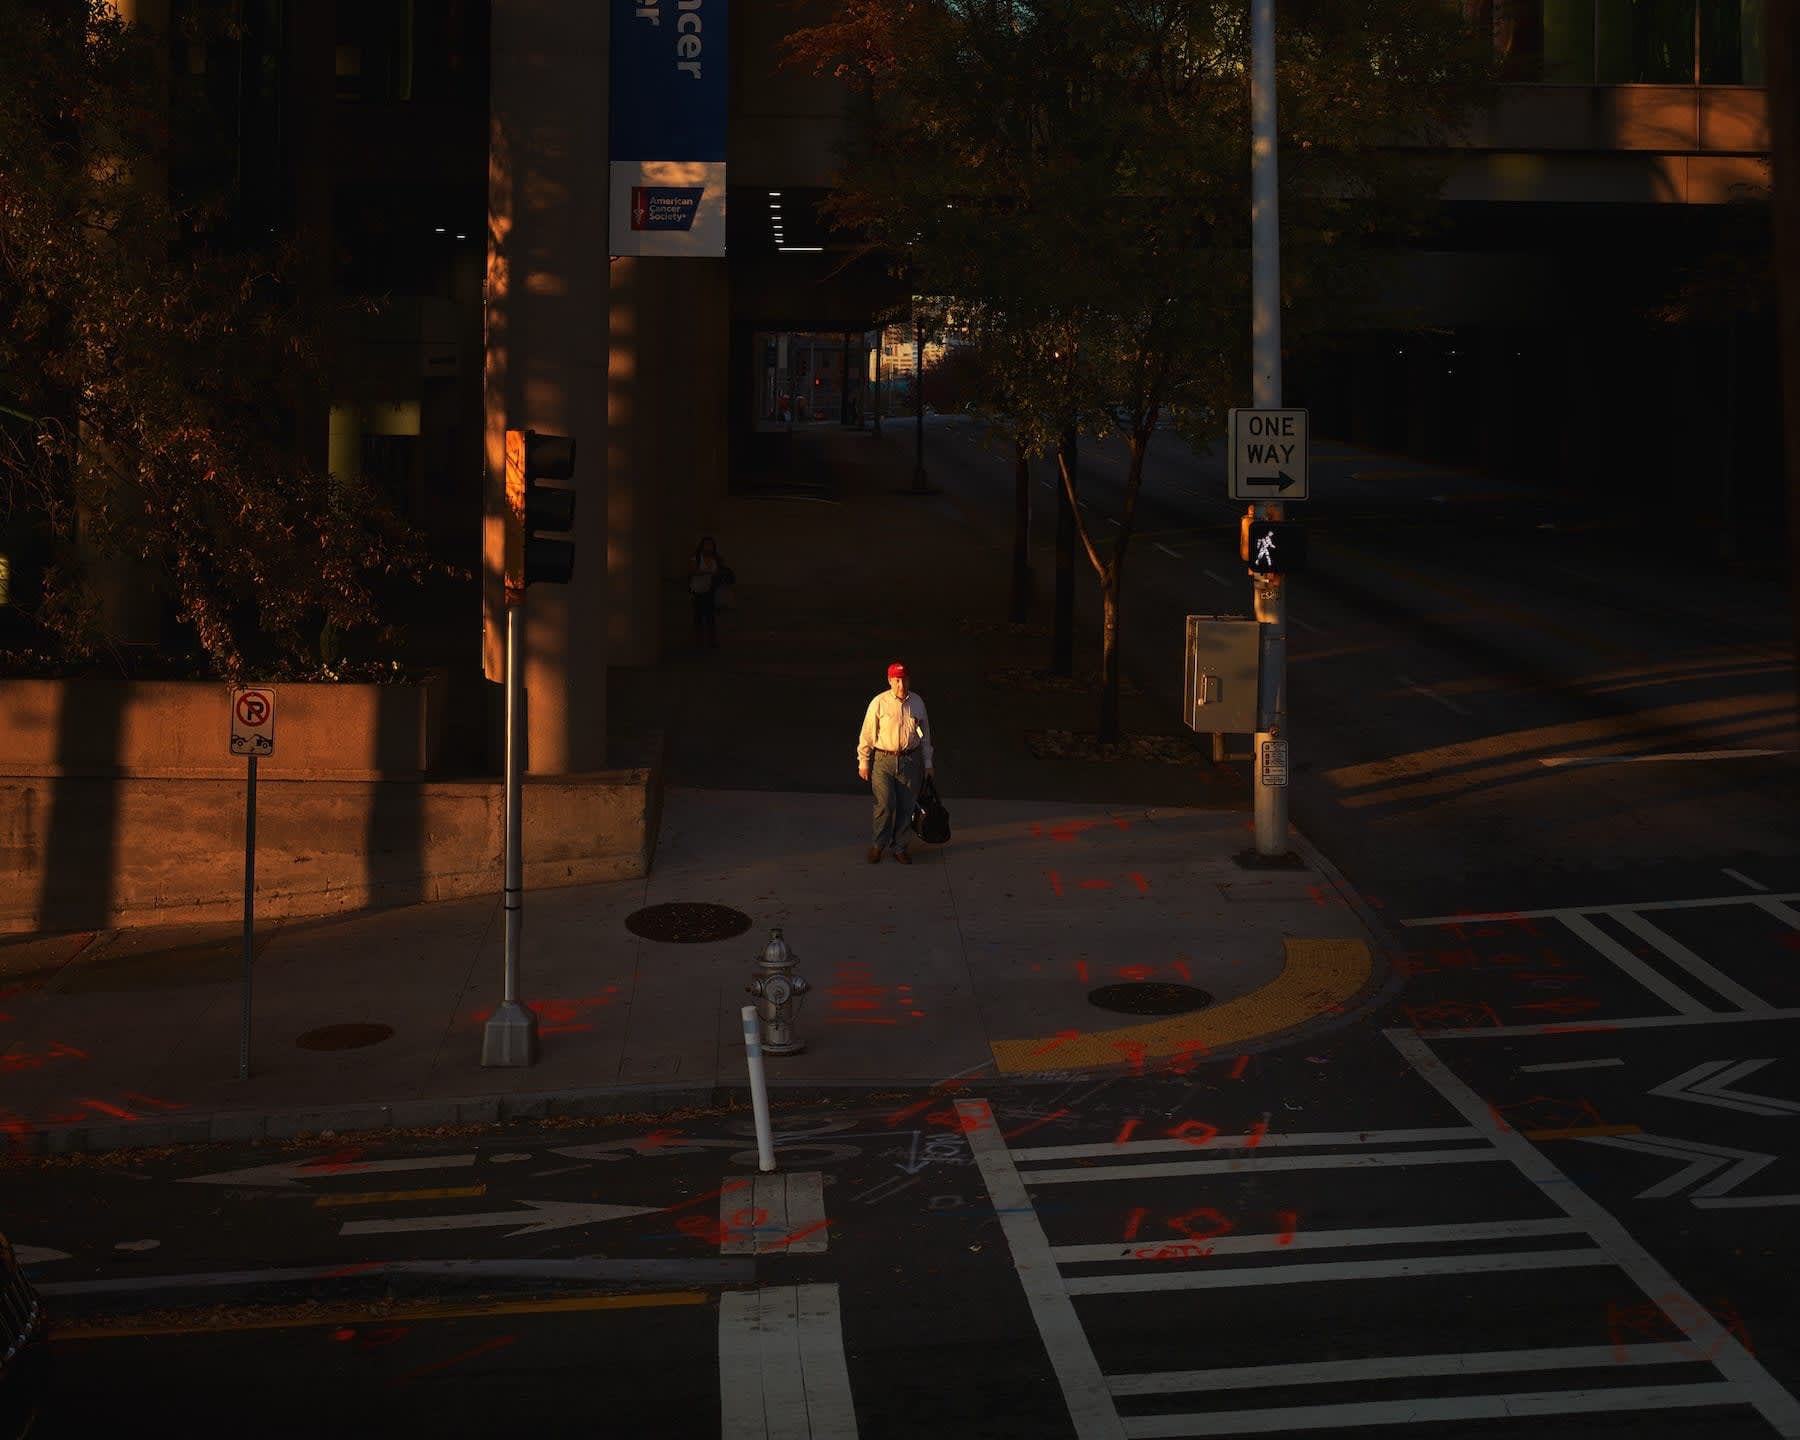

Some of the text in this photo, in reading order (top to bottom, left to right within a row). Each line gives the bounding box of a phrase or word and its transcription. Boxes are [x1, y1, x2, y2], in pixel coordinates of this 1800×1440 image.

[649, 196, 694, 206] American
[649, 205, 682, 213] Cancer
[1249, 416, 1295, 437] ONE
[1247, 444, 1296, 464] WAY
